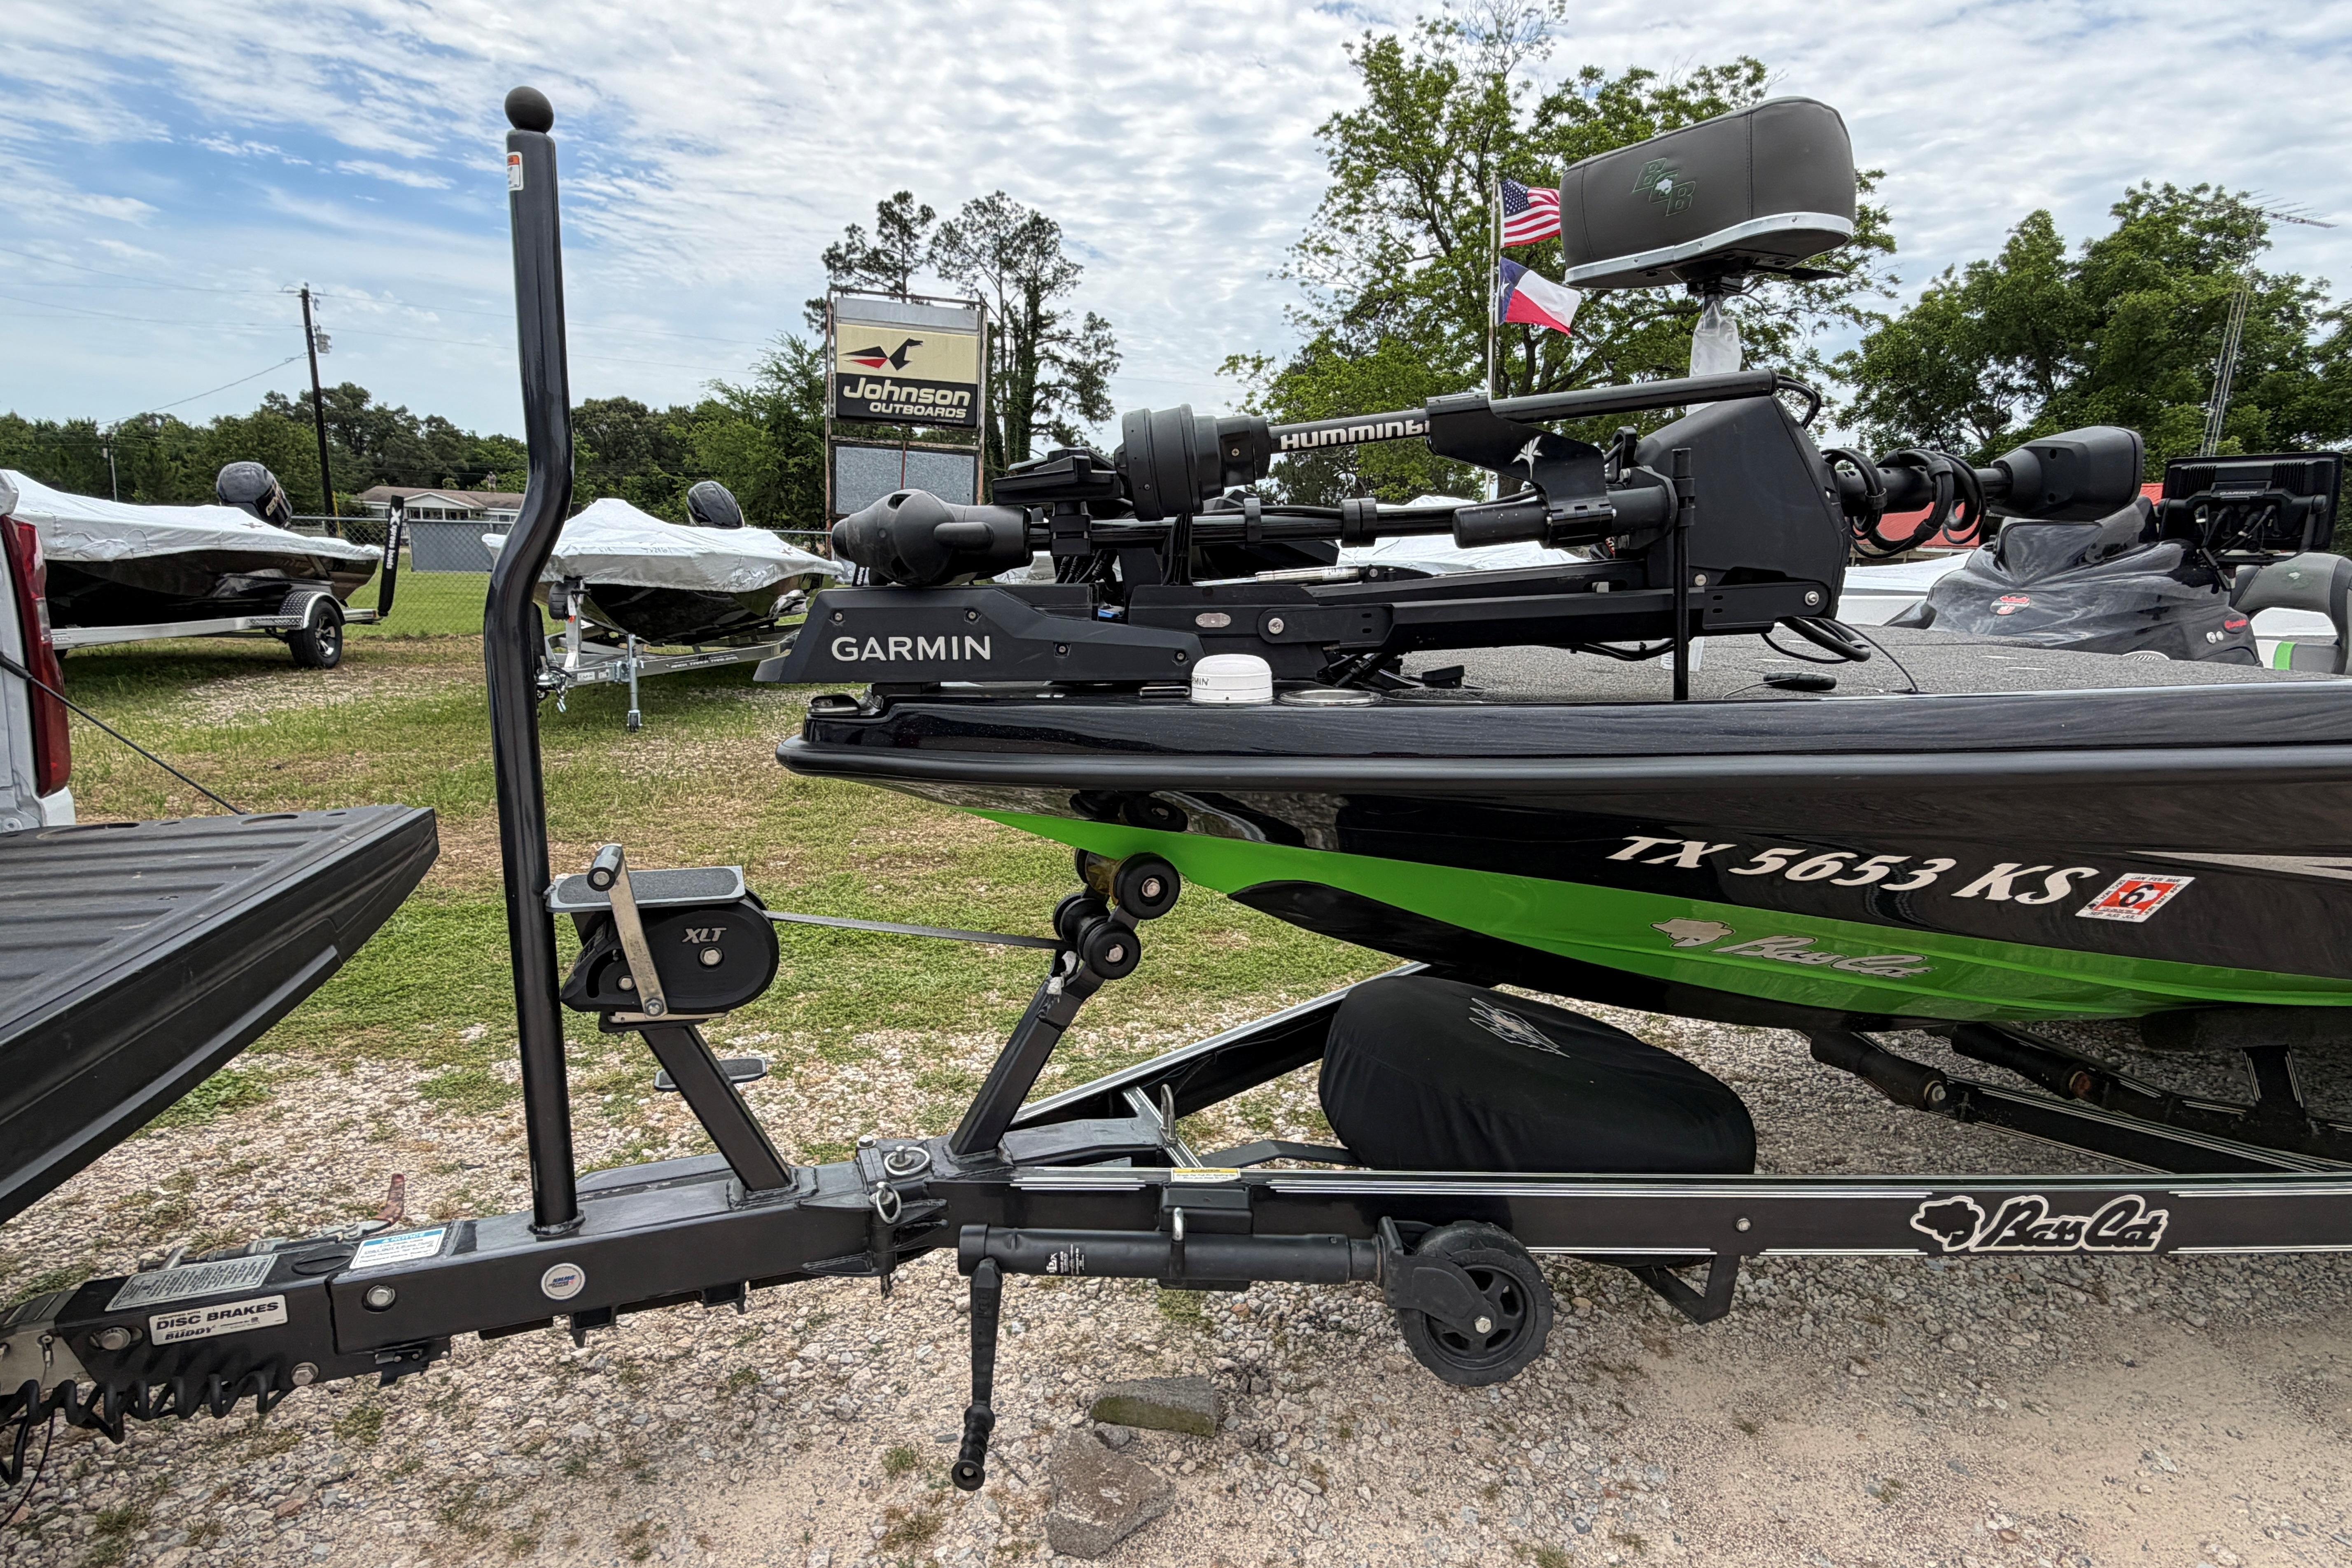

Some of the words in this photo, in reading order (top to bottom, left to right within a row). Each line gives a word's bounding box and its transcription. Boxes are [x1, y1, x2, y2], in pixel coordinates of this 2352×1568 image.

[843, 378, 971, 406] Johnson
[869, 402, 966, 418] OUTBOARDS
[831, 636, 991, 661] GARMIN
[1606, 836, 1736, 868] TX
[1729, 848, 1957, 891] 5653
[1952, 863, 2100, 905] KS
[2119, 884, 2154, 906] 6
[682, 927, 727, 943] XLT
[1709, 936, 1848, 965] Bass
[1830, 954, 1936, 978] Cat
[1969, 1195, 2090, 1251] Bass
[2082, 1195, 2169, 1251] Cat
[156, 1315, 201, 1330] DISC
[207, 1302, 279, 1322] BRAKES
[165, 1325, 215, 1340] BUDDY
